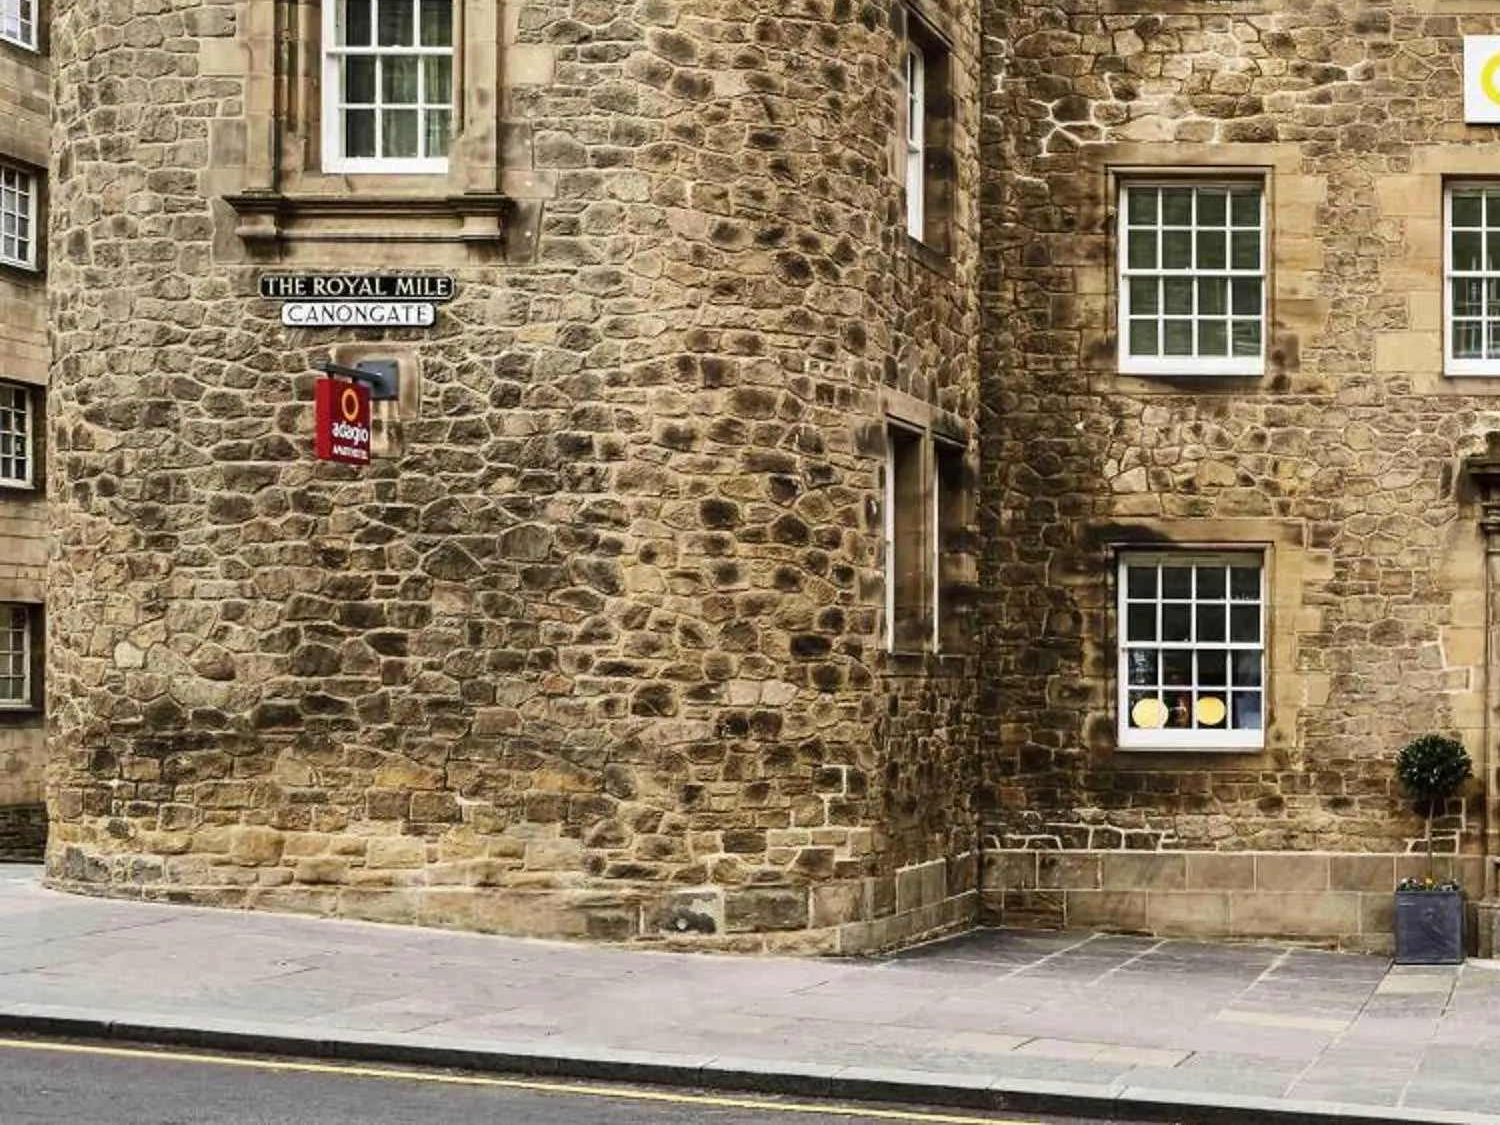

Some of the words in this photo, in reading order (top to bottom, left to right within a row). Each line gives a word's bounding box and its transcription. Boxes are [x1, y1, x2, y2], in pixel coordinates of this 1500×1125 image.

[264, 277, 305, 296] THE
[313, 277, 386, 296] ROYAL
[396, 277, 449, 296] MILE
[287, 304, 428, 323] CANONGATE
[331, 420, 369, 445] adagio
